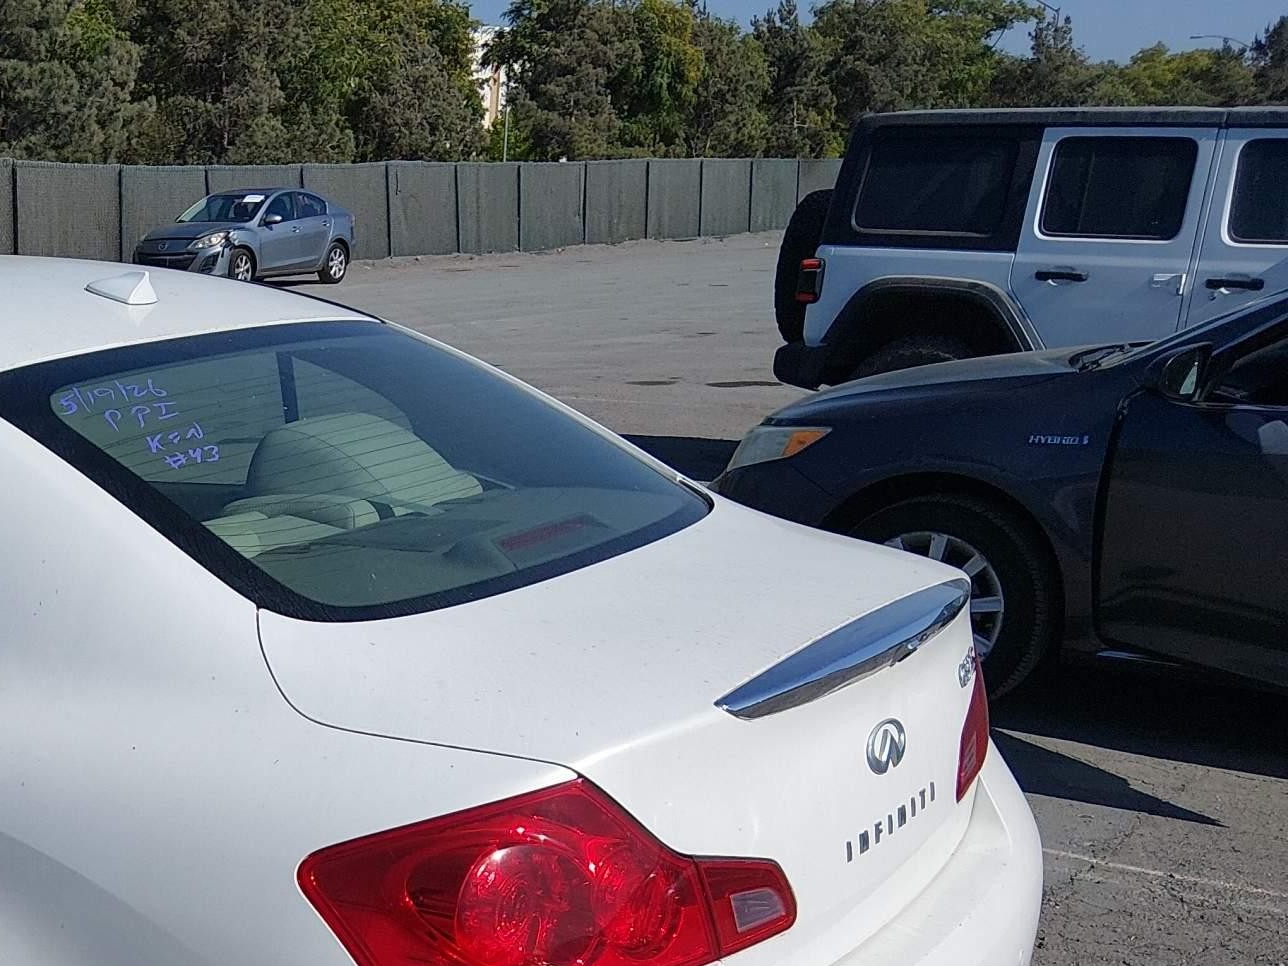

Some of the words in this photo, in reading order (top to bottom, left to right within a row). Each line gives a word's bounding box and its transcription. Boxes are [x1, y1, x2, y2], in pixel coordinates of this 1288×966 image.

[60, 379, 168, 415] 5/19/26
[1028, 435, 1080, 445] HYBRID
[164, 445, 220, 469] #43
[846, 781, 936, 863] INFINITI
